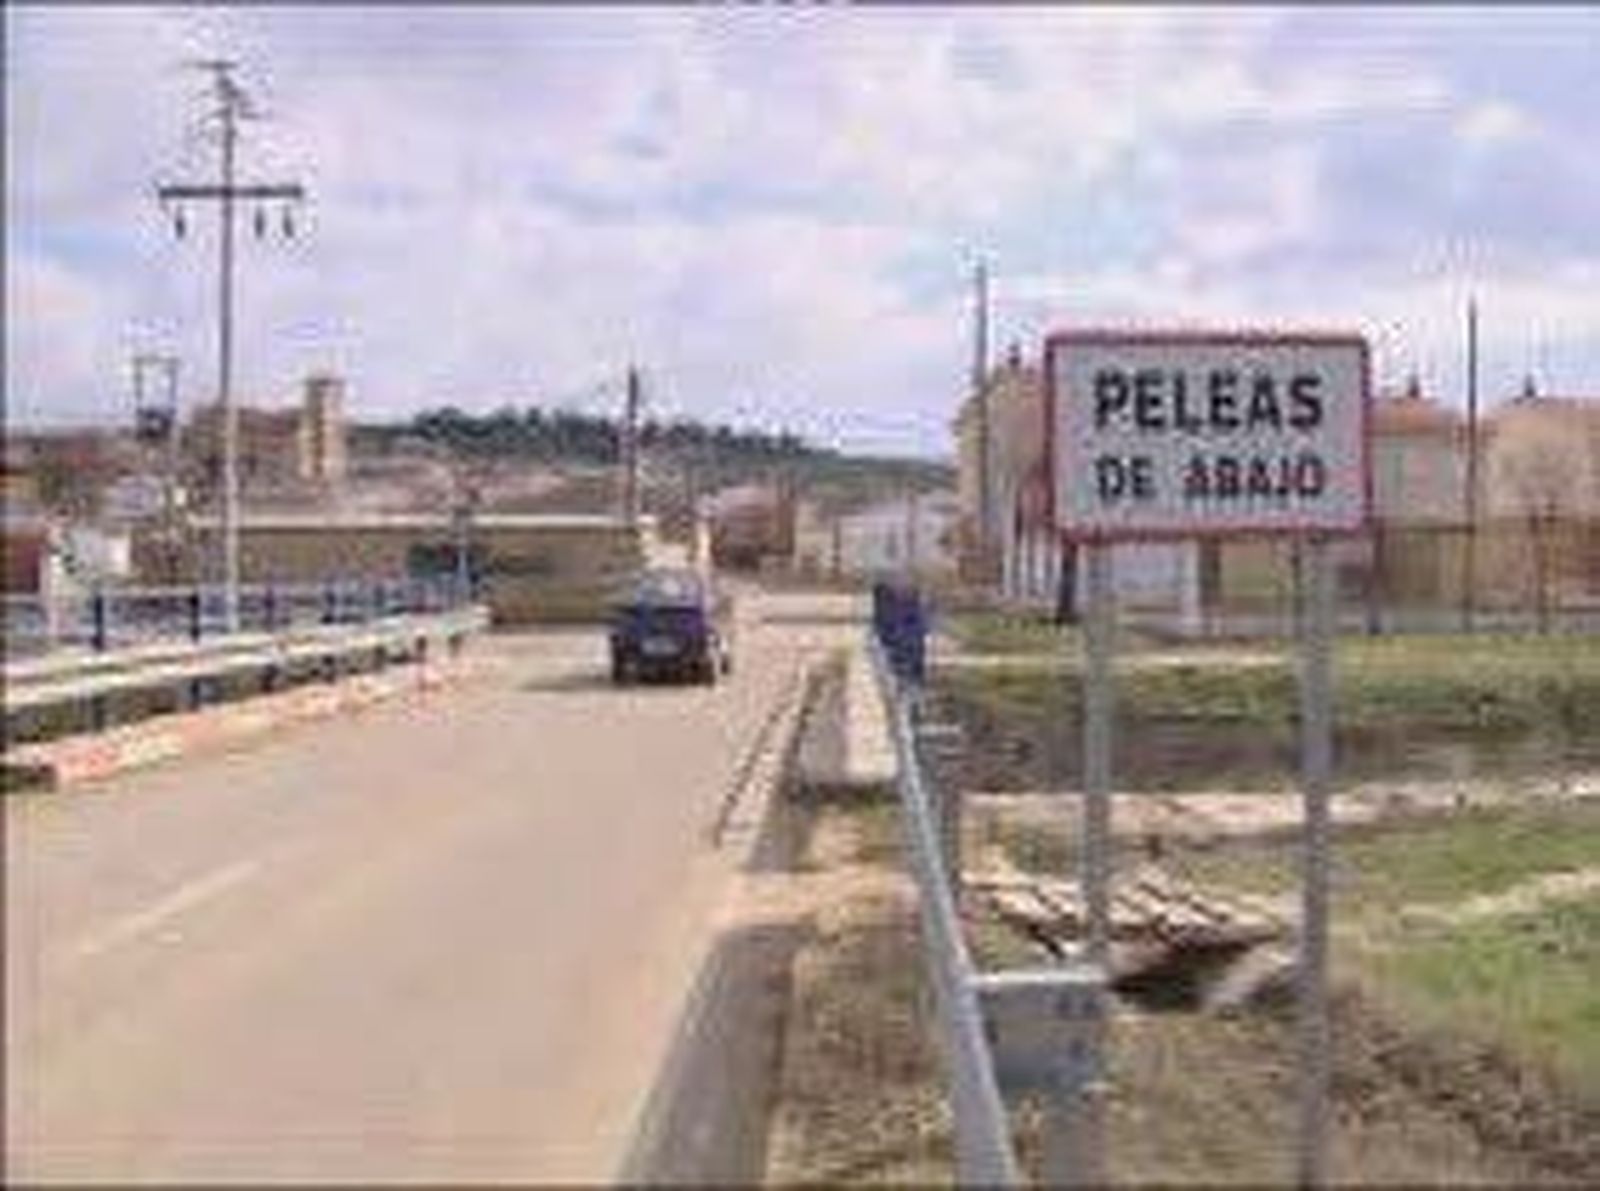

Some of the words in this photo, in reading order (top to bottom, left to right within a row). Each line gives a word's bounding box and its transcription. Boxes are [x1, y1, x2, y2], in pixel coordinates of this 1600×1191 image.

[1094, 370, 1323, 430] PELEAS
[1095, 456, 1153, 499] DE
[1184, 456, 1325, 499] ABAJO
